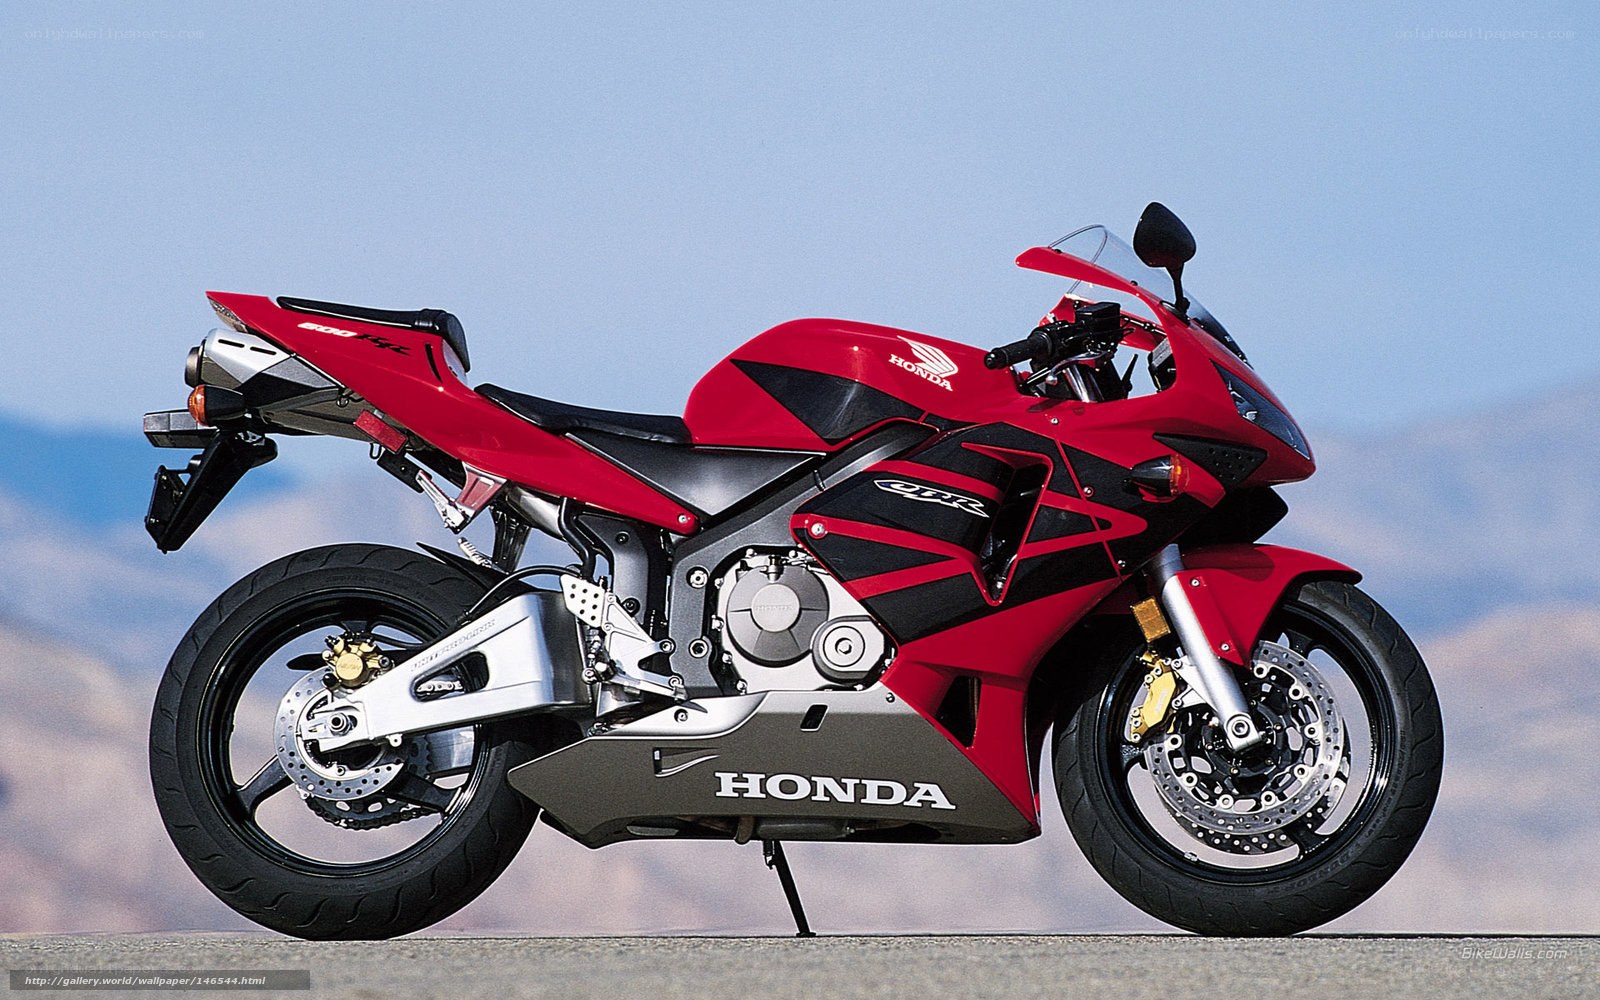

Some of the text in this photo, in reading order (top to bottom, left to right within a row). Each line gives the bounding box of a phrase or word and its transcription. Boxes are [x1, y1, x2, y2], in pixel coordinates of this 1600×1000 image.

[888, 354, 953, 391] HONDA
[873, 479, 990, 518] CBR
[714, 771, 957, 810] HONDA
